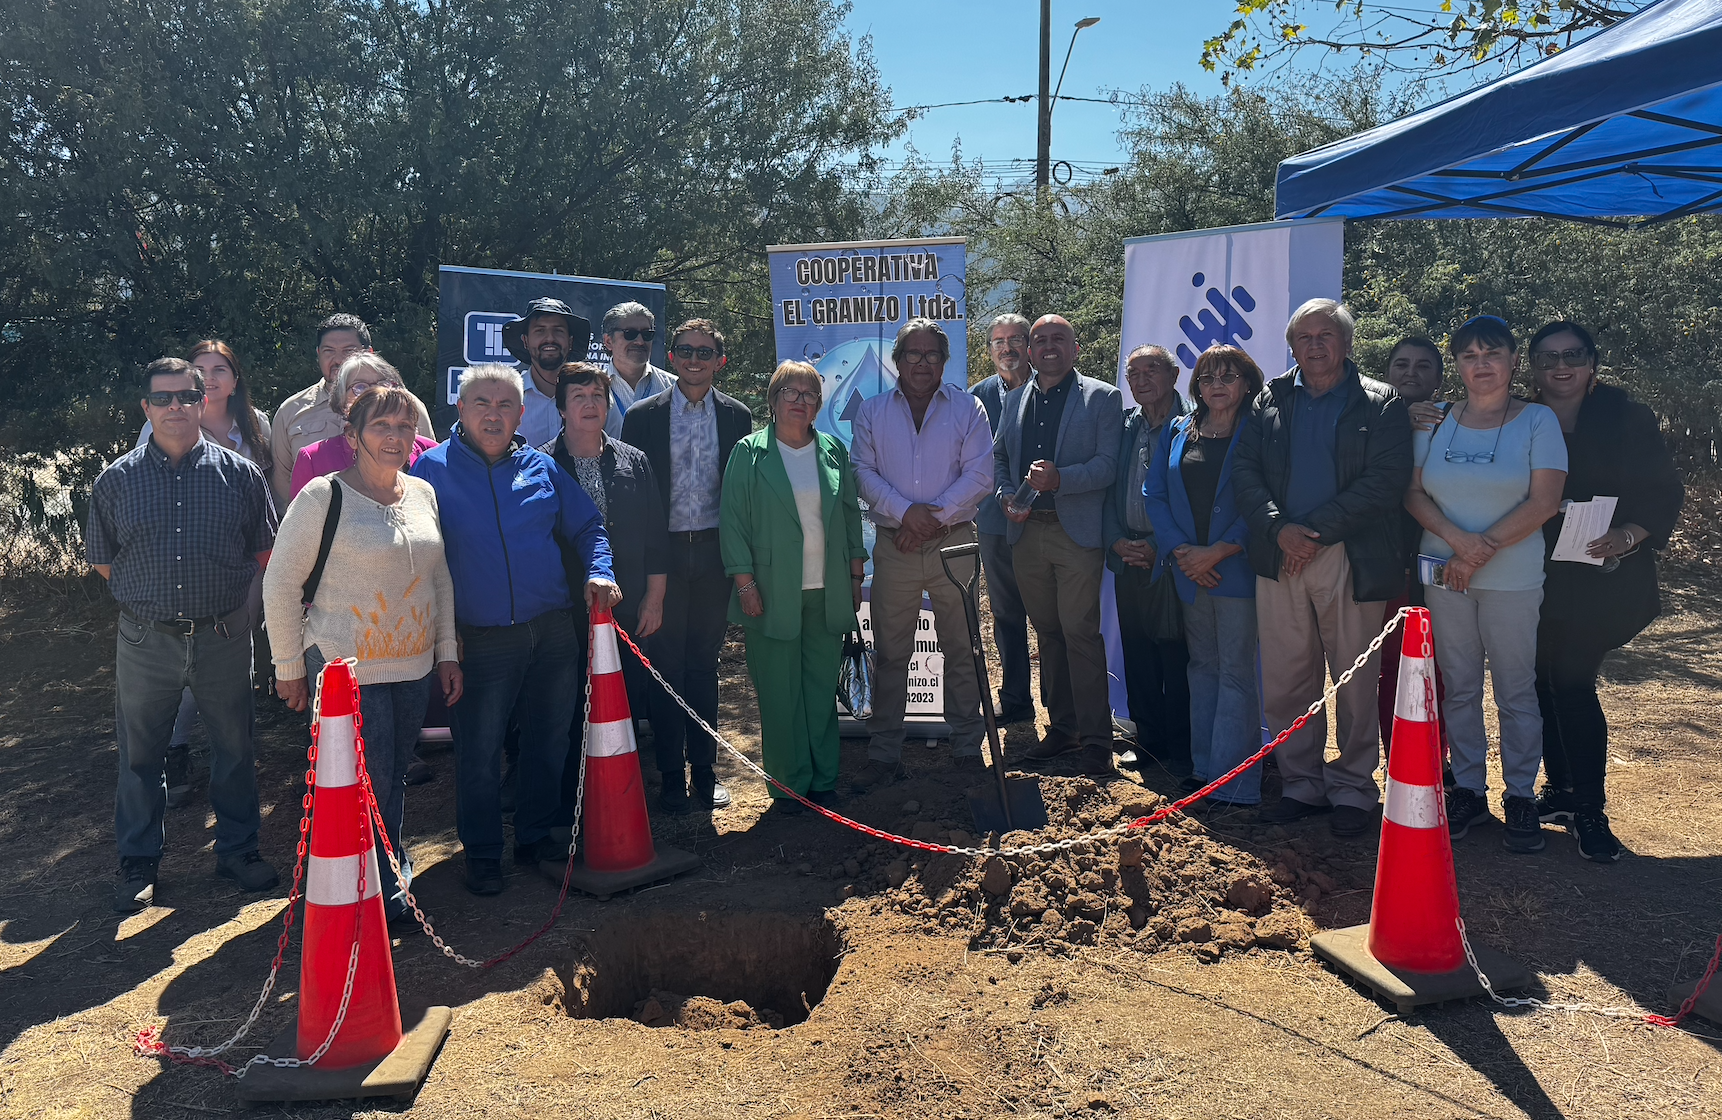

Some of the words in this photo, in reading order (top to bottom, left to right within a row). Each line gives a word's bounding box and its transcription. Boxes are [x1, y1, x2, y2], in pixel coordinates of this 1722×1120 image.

[796, 252, 939, 286] COOPERATIVA
[783, 299, 807, 326] EL
[811, 296, 900, 325] GRANIZO
[906, 293, 965, 322] Ltda.
[908, 675, 939, 688] nizo.cl
